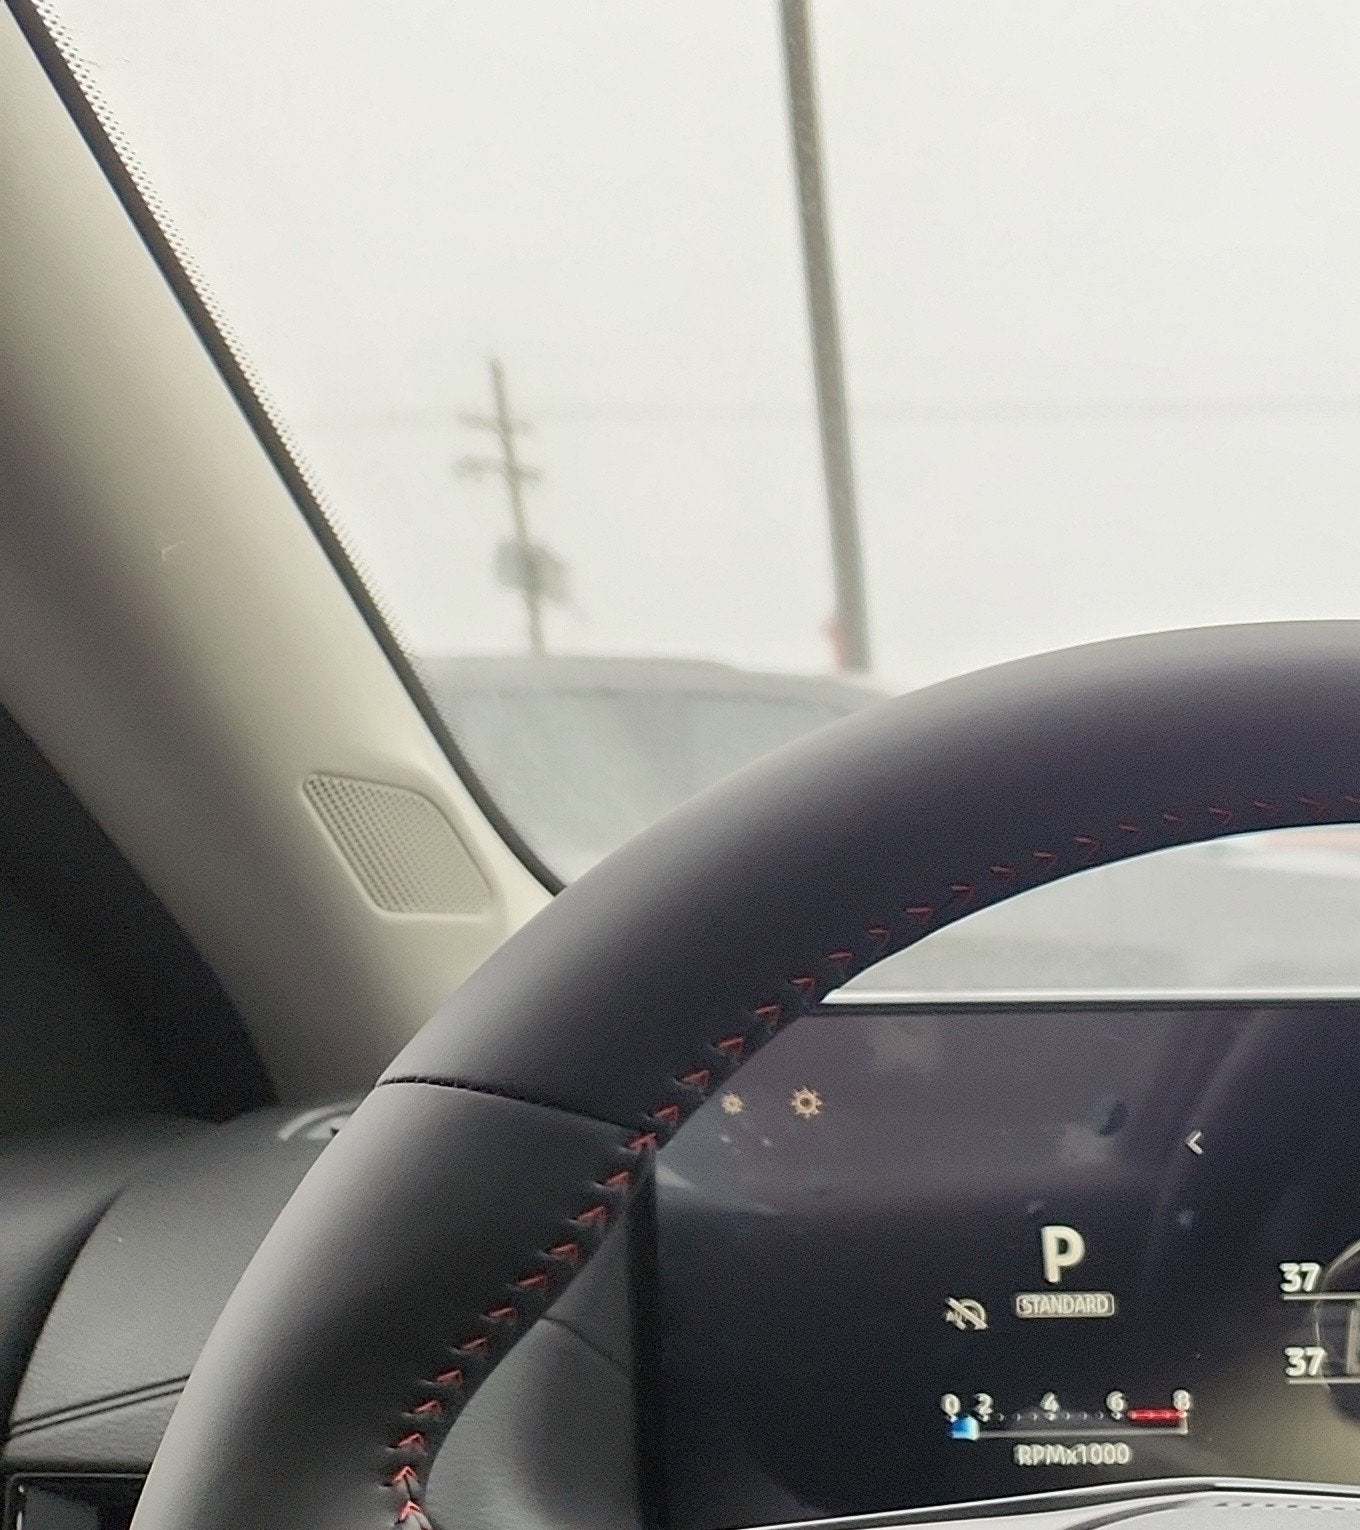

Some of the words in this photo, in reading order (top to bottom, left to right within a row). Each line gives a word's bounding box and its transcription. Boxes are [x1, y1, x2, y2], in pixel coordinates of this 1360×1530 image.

[1041, 1225, 1086, 1283] P
[1279, 1262, 1322, 1292] 37
[1020, 1293, 1110, 1315] STANDARD
[1284, 1346, 1326, 1377] 37
[940, 1393, 961, 1415] 0
[974, 1392, 994, 1414] 2
[1040, 1391, 1060, 1413] 4
[1105, 1390, 1126, 1413] 6
[1172, 1389, 1191, 1412] 8
[1013, 1441, 1133, 1466] RPMx1000
